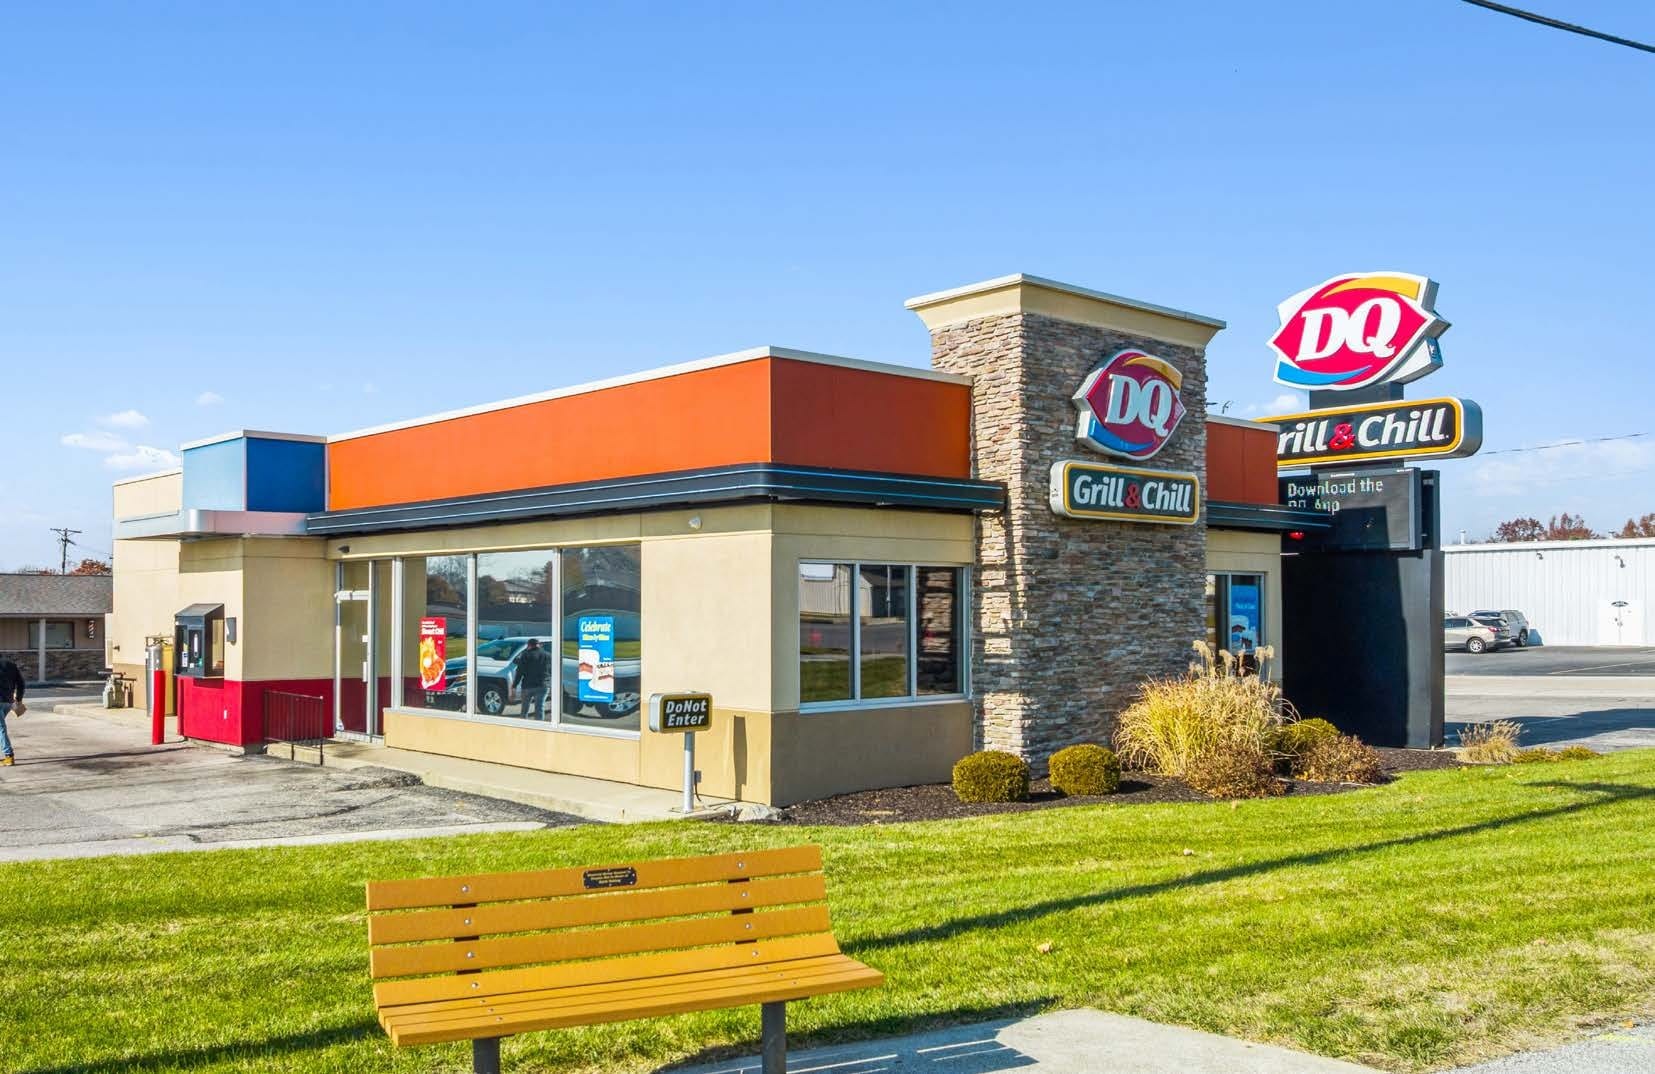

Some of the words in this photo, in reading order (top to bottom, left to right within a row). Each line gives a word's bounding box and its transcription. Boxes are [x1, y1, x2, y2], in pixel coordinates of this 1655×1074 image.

[1295, 297, 1401, 361] DQ
[1105, 374, 1172, 437] DQ
[1142, 481, 1192, 512] Chill
[1288, 478, 1356, 497] Download
[1360, 477, 1383, 493] the
[667, 713, 705, 727] Enter
